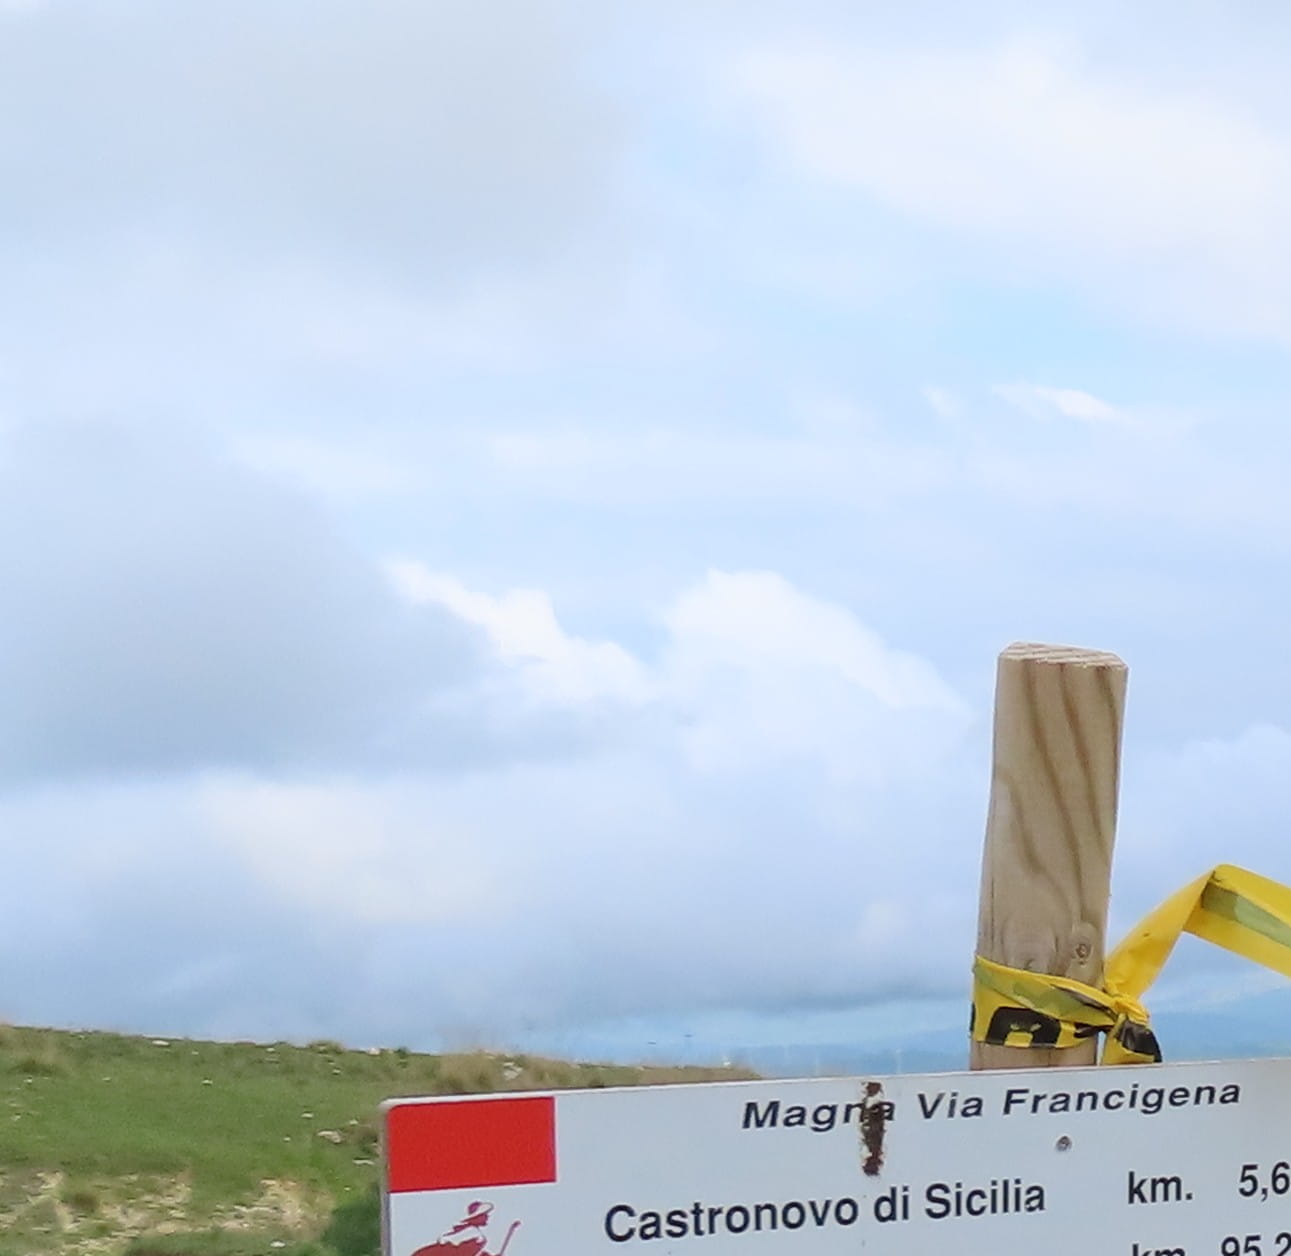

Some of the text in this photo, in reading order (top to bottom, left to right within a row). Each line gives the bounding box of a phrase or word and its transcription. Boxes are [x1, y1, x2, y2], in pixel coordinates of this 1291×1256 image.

[917, 1092, 983, 1120] Via
[1003, 1083, 1241, 1115] Francigena
[1128, 1170, 1193, 1205] km.
[604, 1178, 1045, 1243] Castronovo di Sicilia
